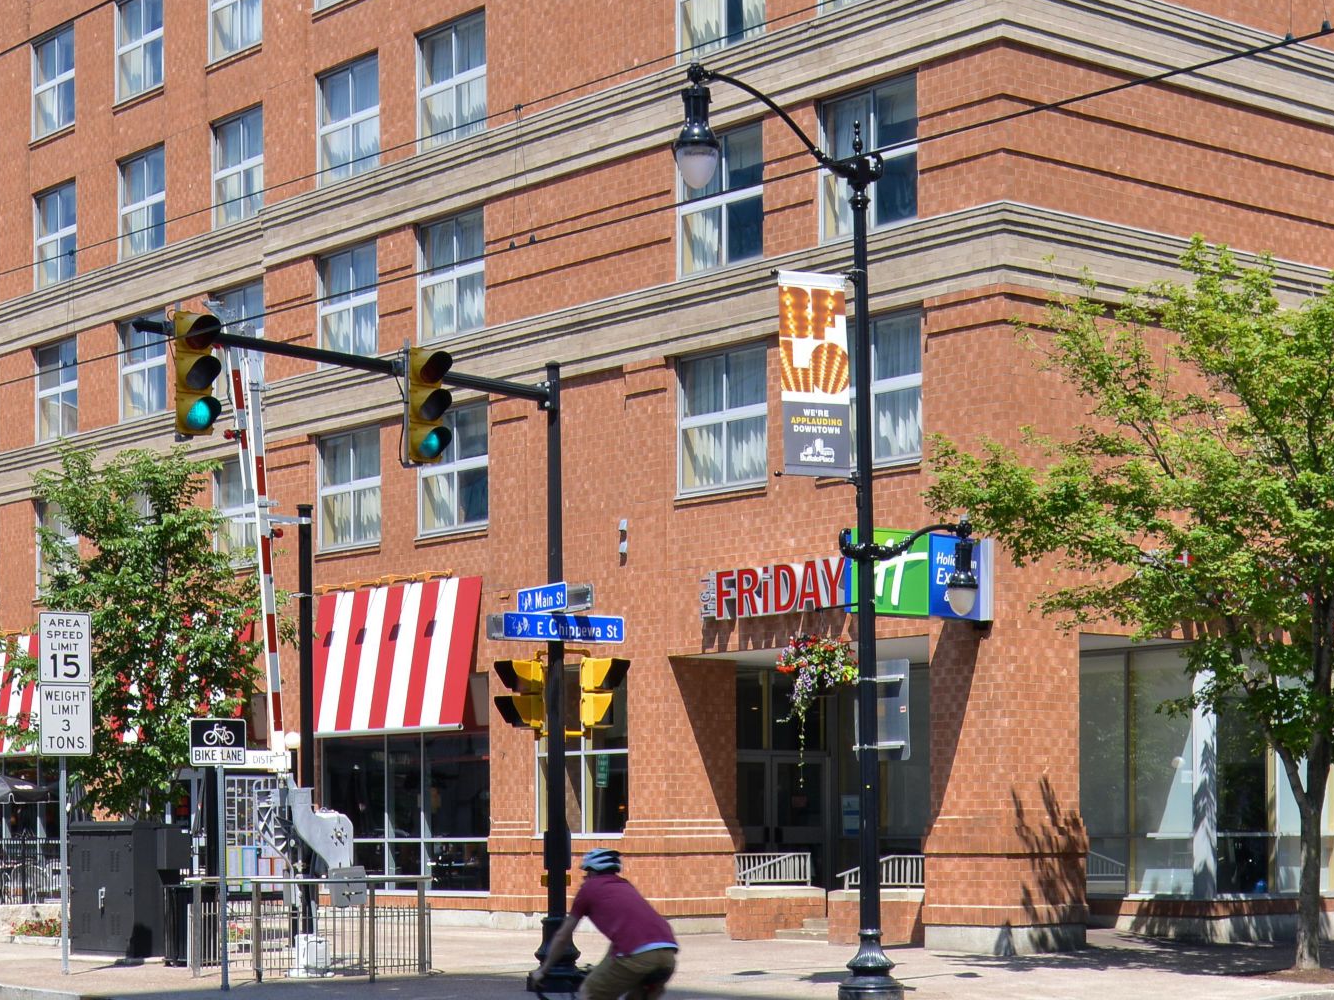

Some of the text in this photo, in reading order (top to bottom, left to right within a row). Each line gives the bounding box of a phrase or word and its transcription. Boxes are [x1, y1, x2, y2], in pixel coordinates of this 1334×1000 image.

[803, 408, 829, 417] WE'RE
[791, 416, 843, 426] APPLAUDING
[793, 424, 841, 435] DOWNTOWN
[535, 591, 564, 609] Main St
[49, 619, 80, 628] AREA
[549, 618, 601, 639] Chippewa
[607, 625, 617, 638] St
[46, 631, 83, 639] SPEED
[51, 643, 79, 651] LIMIT
[50, 653, 81, 678] 15
[45, 691, 86, 701] WEIGHT
[51, 705, 80, 715] LIMIT
[61, 719, 71, 731] 3
[48, 737, 85, 749] TONS
[194, 750, 242, 761] BIKE LANE
